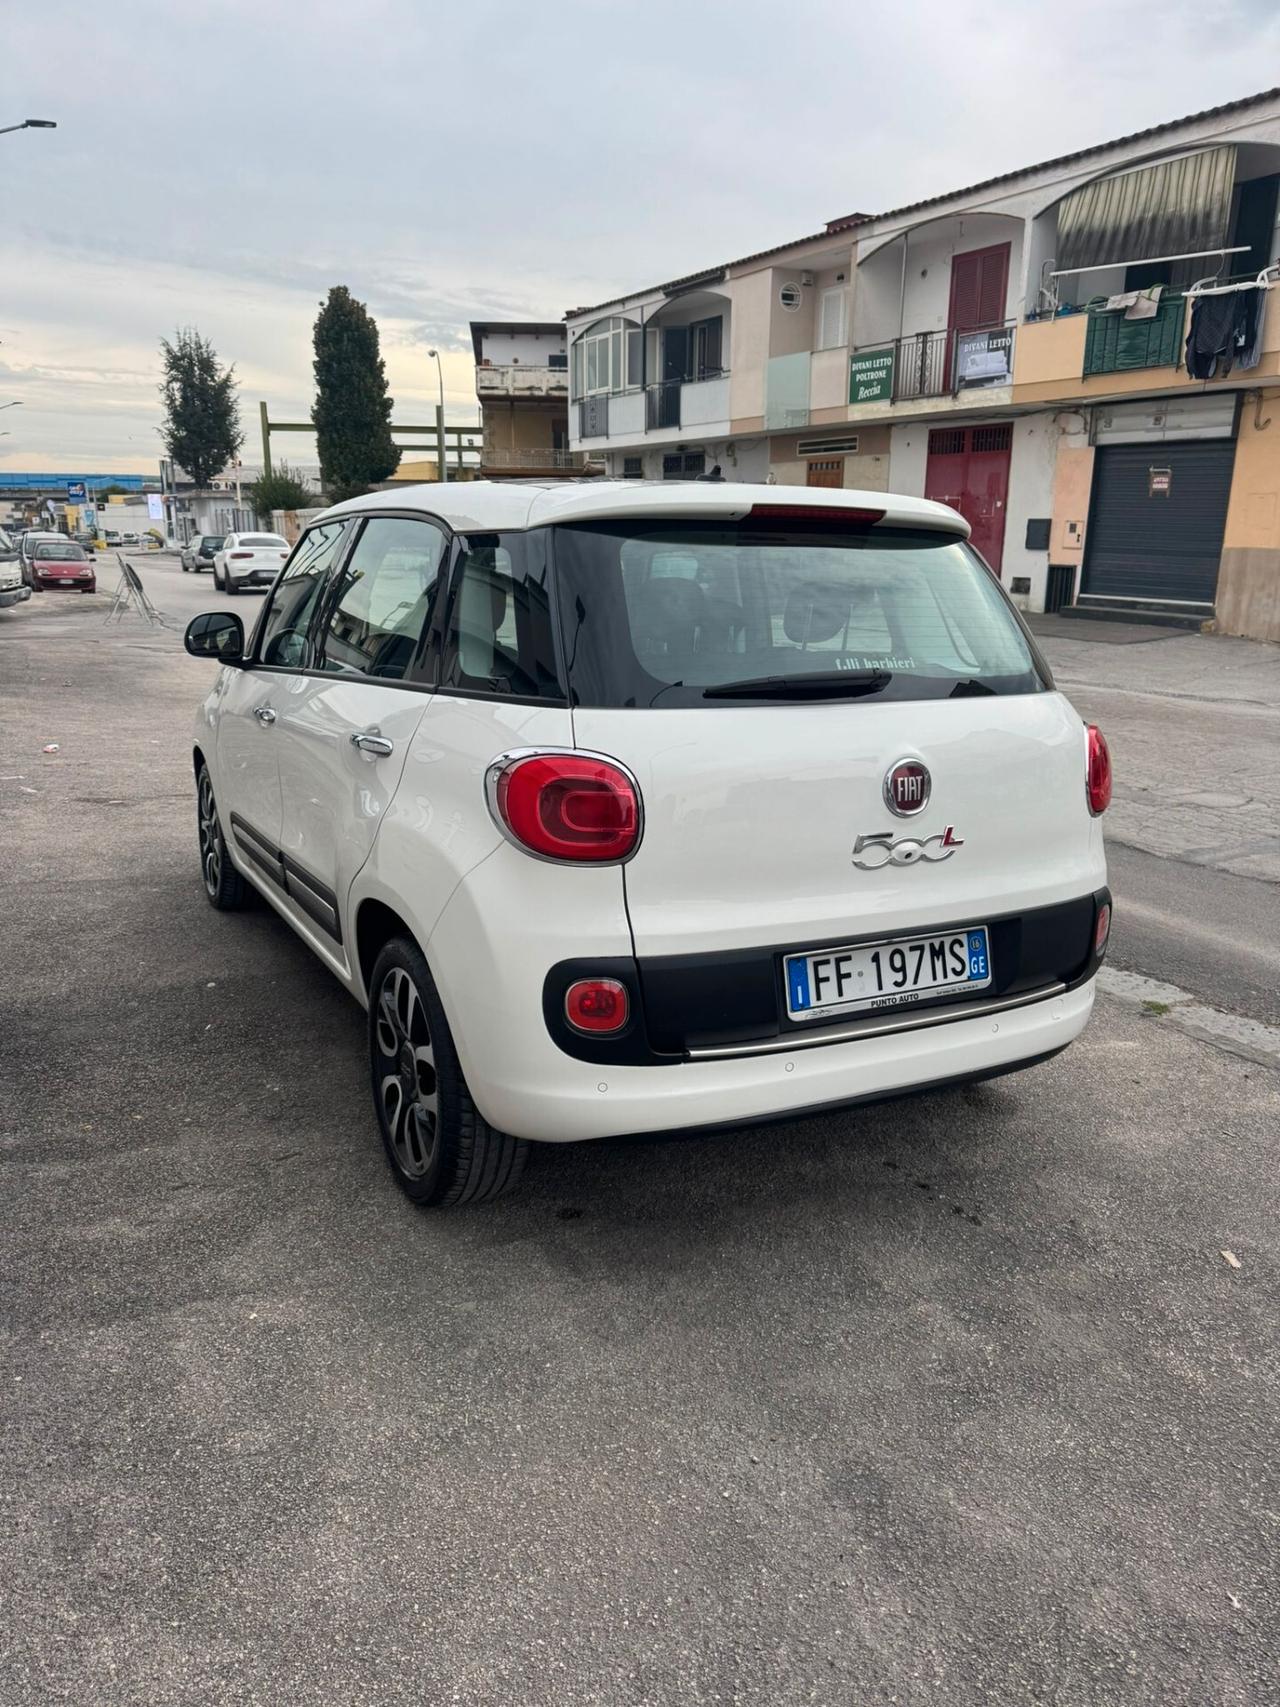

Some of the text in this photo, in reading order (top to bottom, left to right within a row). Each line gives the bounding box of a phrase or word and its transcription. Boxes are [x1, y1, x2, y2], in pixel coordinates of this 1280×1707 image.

[964, 336, 1011, 352] DIVANI LETTO
[852, 356, 892, 371] DIVANI LETTO
[856, 369, 887, 382] POLTRONE
[863, 657, 915, 669] barbieri
[897, 775, 923, 802] FIAT
[852, 824, 965, 871] 500L
[970, 956, 985, 974] GE
[871, 992, 920, 1008] PUNTO AUTO
